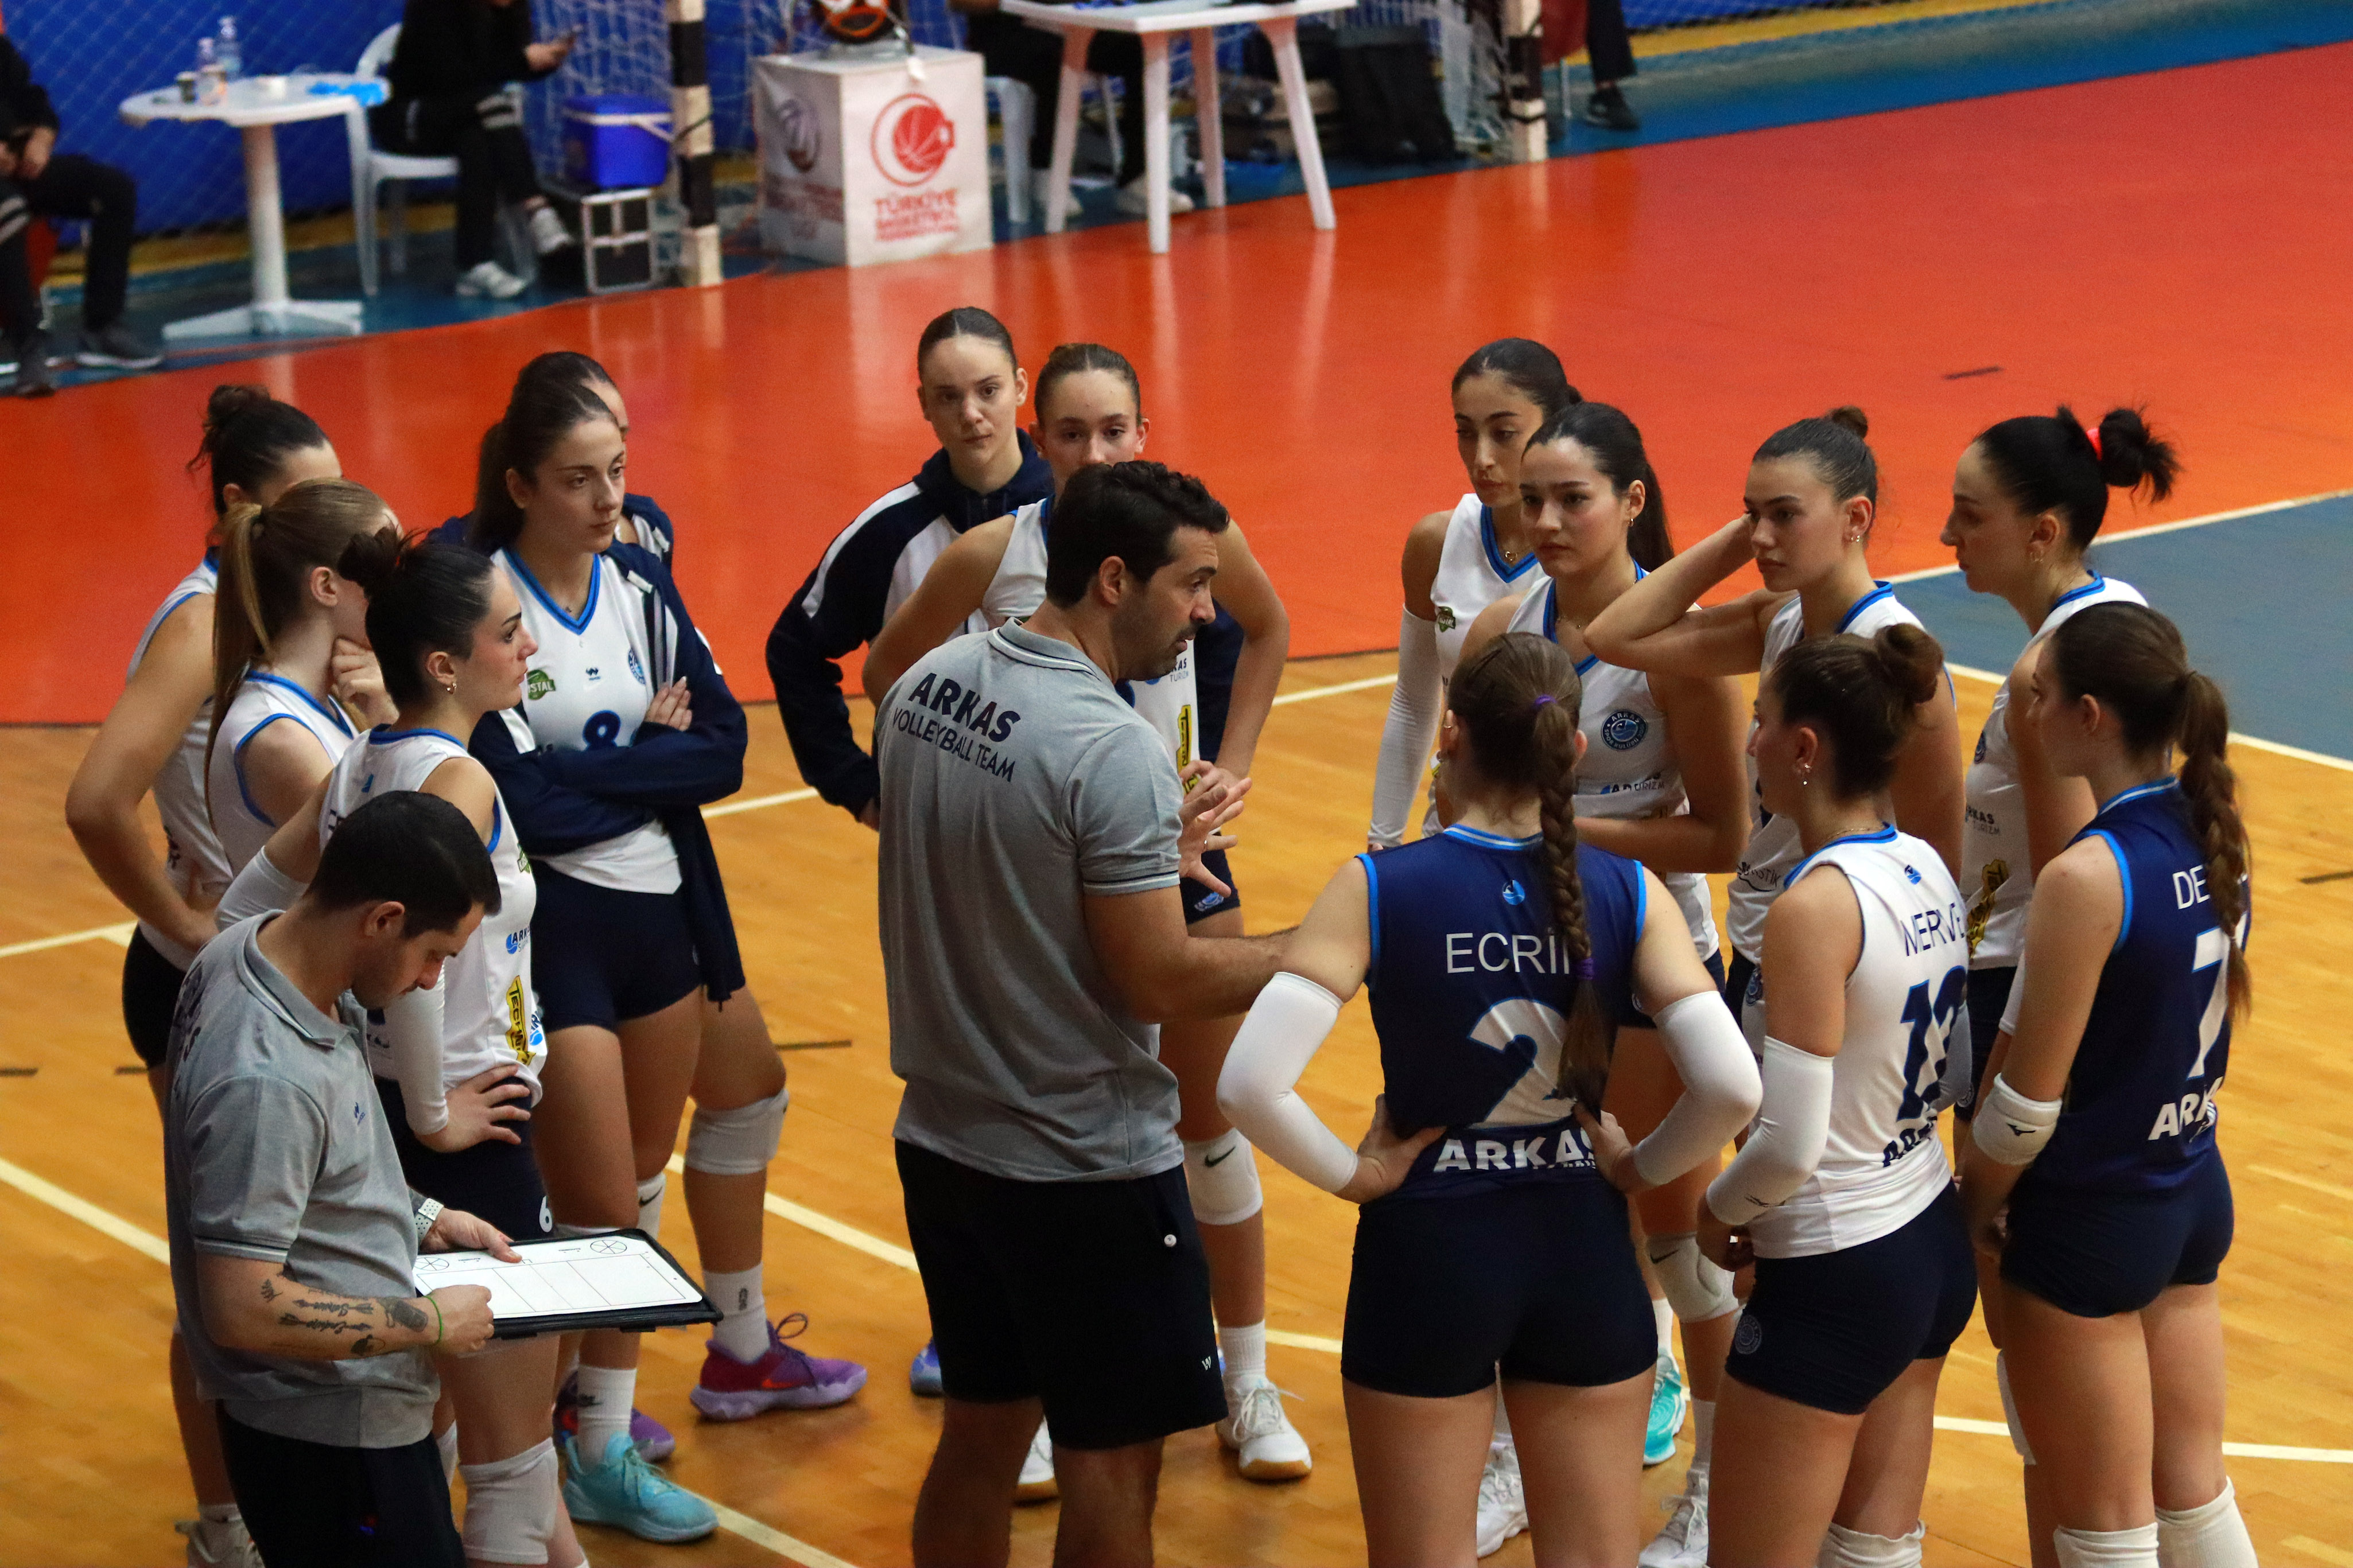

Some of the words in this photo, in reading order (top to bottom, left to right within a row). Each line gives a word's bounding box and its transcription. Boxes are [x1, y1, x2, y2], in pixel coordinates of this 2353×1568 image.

[892, 707, 974, 761] VOLLEYBALL
[975, 744, 1016, 783] TEAM
[908, 672, 1021, 742] ARKAS
[1611, 713, 1640, 723] ARKAS
[2186, 912, 2247, 1081] 7
[1466, 997, 1577, 1129] 2
